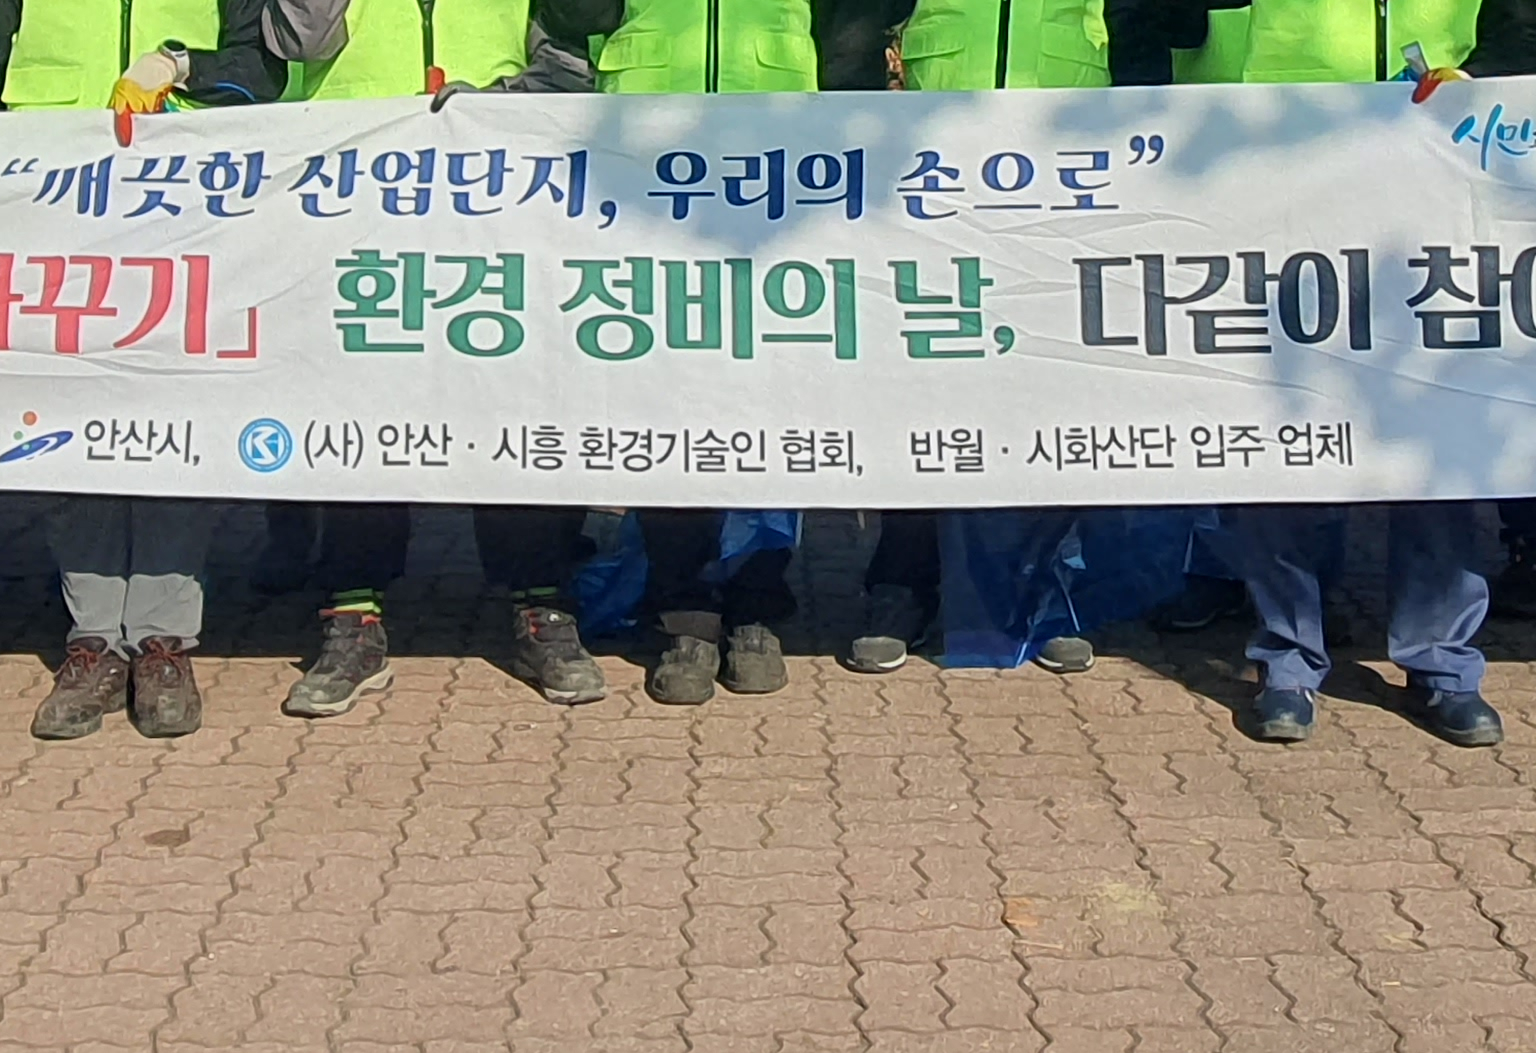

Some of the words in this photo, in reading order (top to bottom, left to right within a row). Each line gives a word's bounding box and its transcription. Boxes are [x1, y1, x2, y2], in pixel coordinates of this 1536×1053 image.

[287, 147, 619, 229] 산업단지,
[647, 148, 865, 221] 우리의
[332, 249, 526, 358] 환경
[559, 255, 858, 361] 정비의
[887, 255, 1016, 360] 날,
[1072, 246, 1372, 357] 다같이
[83, 418, 201, 467] 안산시,
[303, 419, 364, 469] (사)
[377, 423, 453, 467] 안산
[491, 424, 566, 471] 시흥
[578, 426, 767, 473] 환경기술인
[779, 429, 865, 476] 협회,
[910, 428, 985, 473] 반월
[1026, 424, 1177, 472] 시화산단
[1189, 424, 1265, 469] 입주
[1277, 421, 1354, 467] 업체
